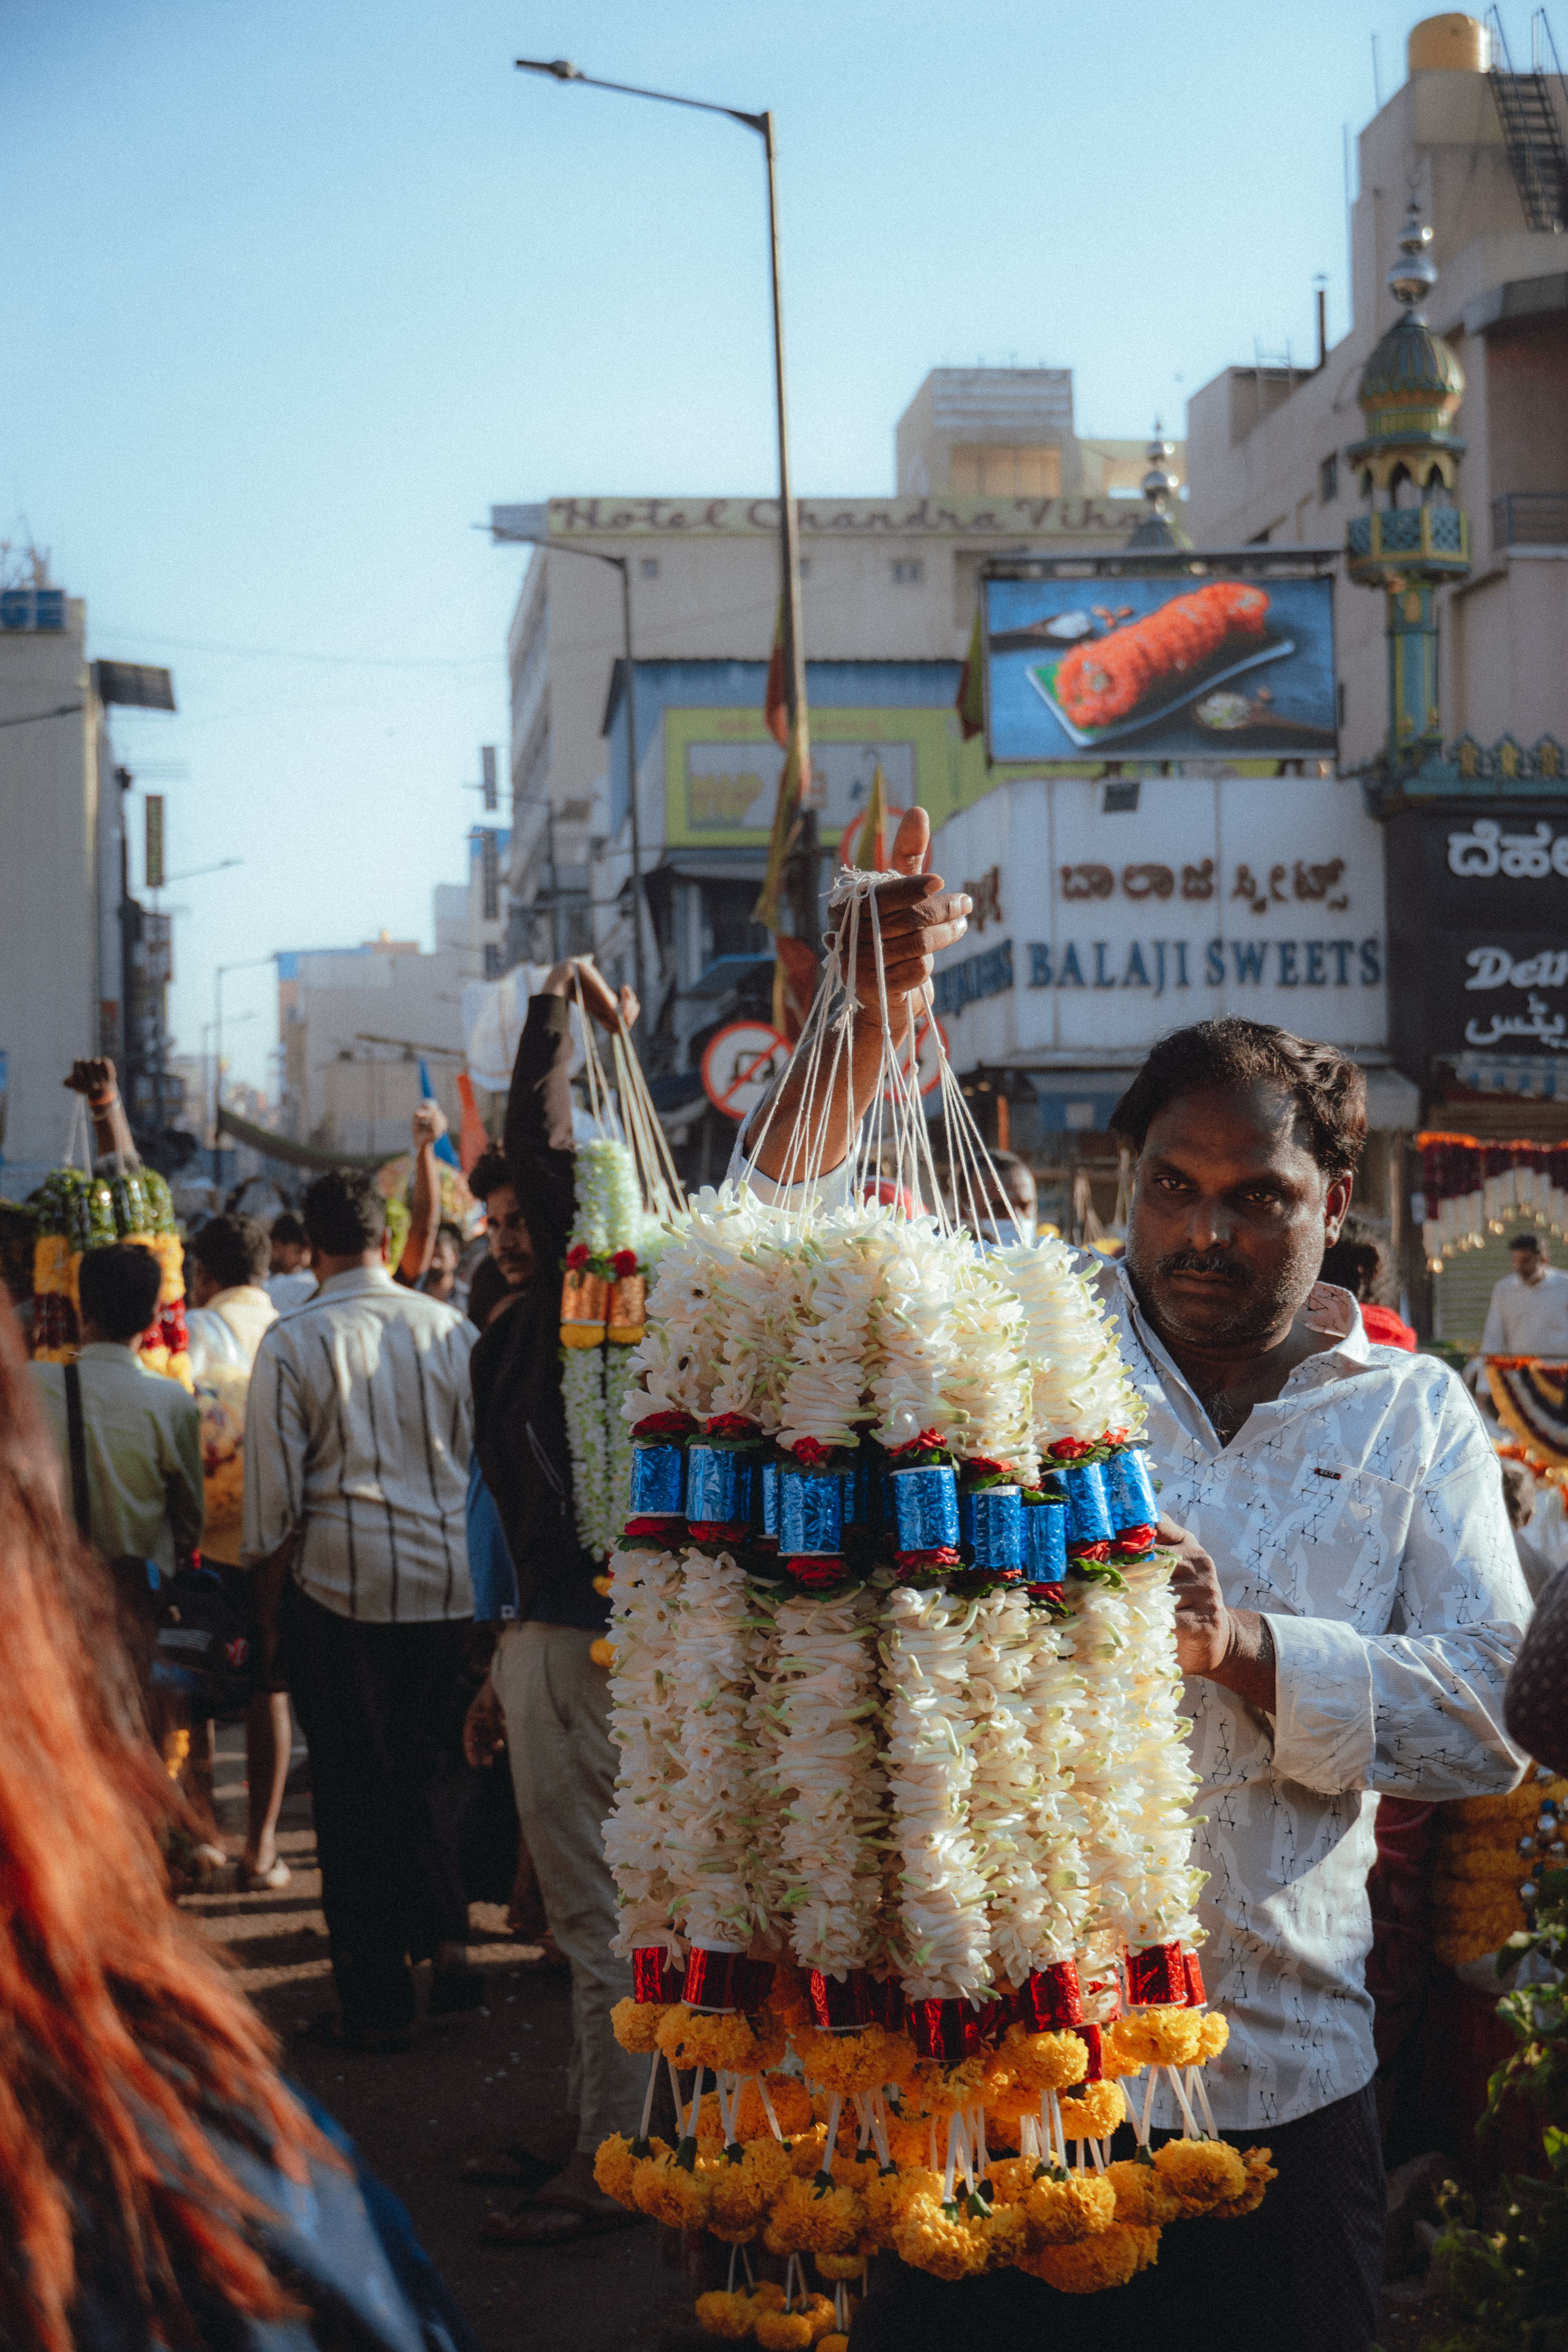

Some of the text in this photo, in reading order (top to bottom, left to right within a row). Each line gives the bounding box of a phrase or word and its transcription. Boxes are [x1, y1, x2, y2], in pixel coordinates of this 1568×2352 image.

[552, 499, 729, 531] Hotel
[746, 499, 1005, 531] Chandra
[1027, 940, 1190, 997] BALAJI
[1205, 937, 1382, 989] SWEETS
